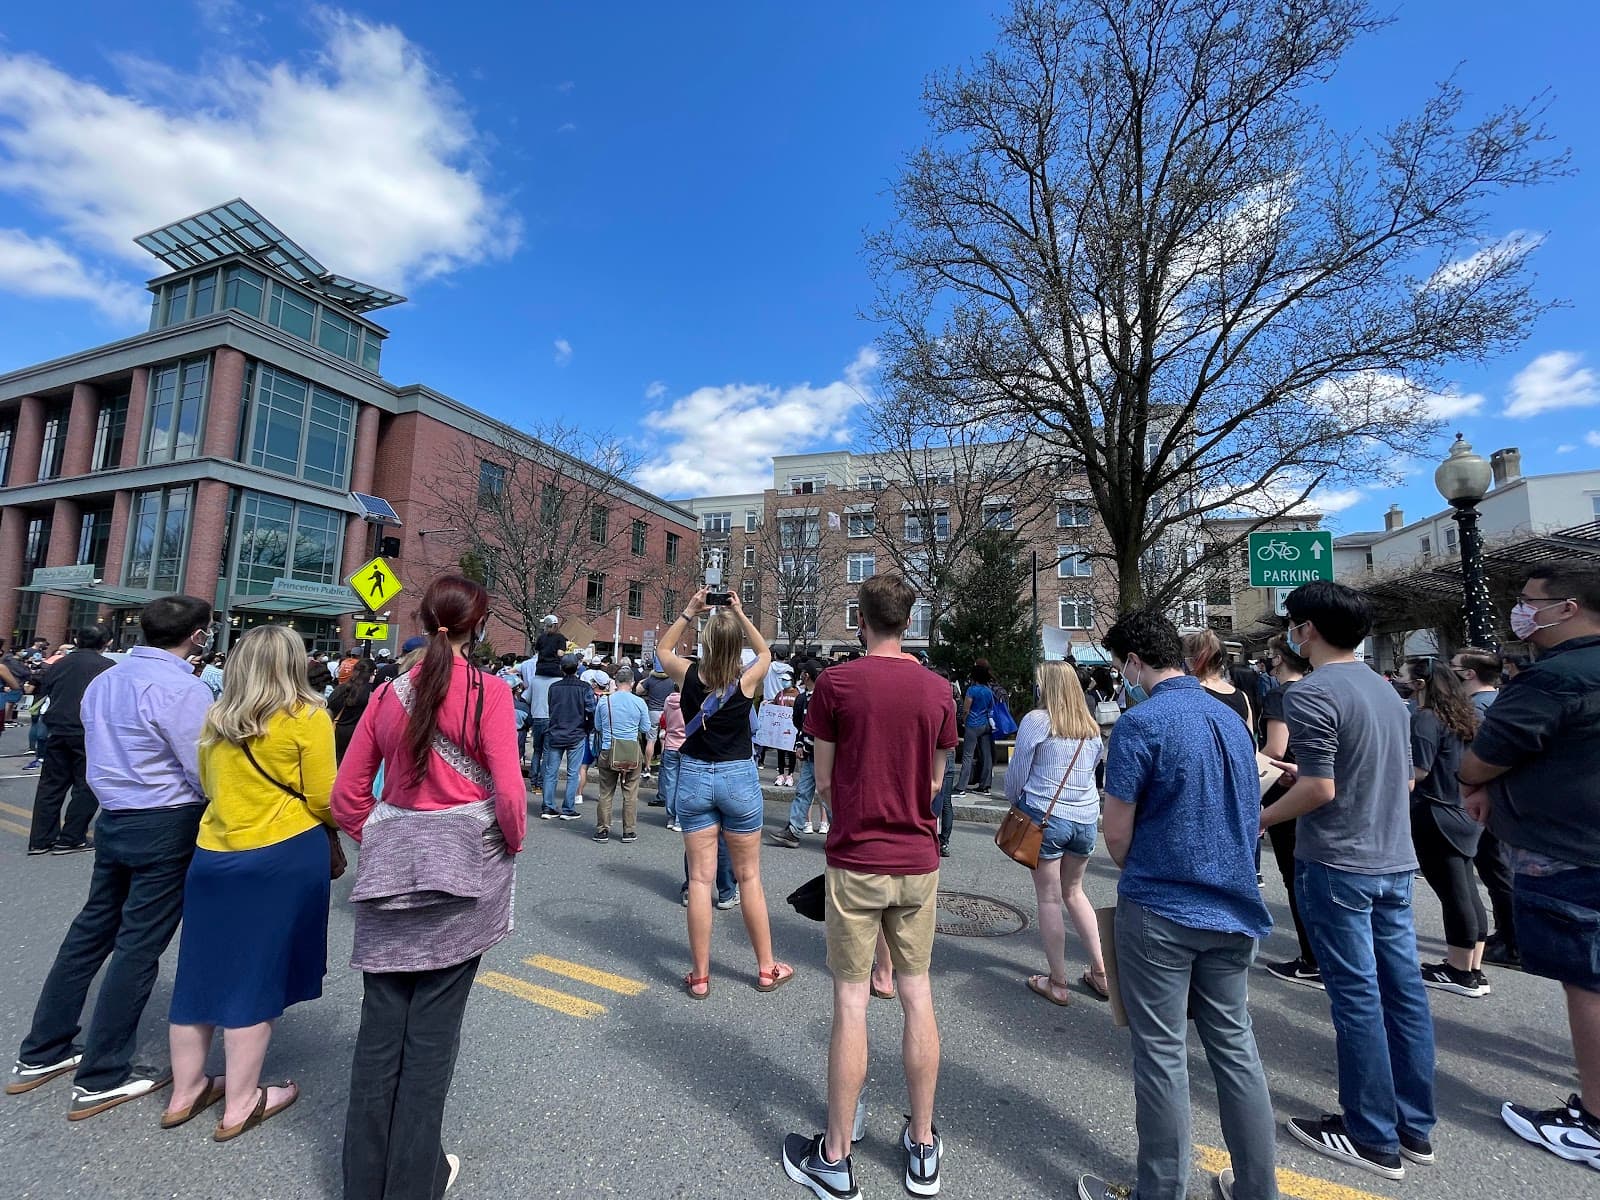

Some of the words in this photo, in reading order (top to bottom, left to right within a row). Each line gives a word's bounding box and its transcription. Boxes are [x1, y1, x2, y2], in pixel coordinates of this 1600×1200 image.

[1263, 570, 1320, 581] PARKING
[278, 581, 319, 593] Princeton
[321, 586, 344, 595] Public
